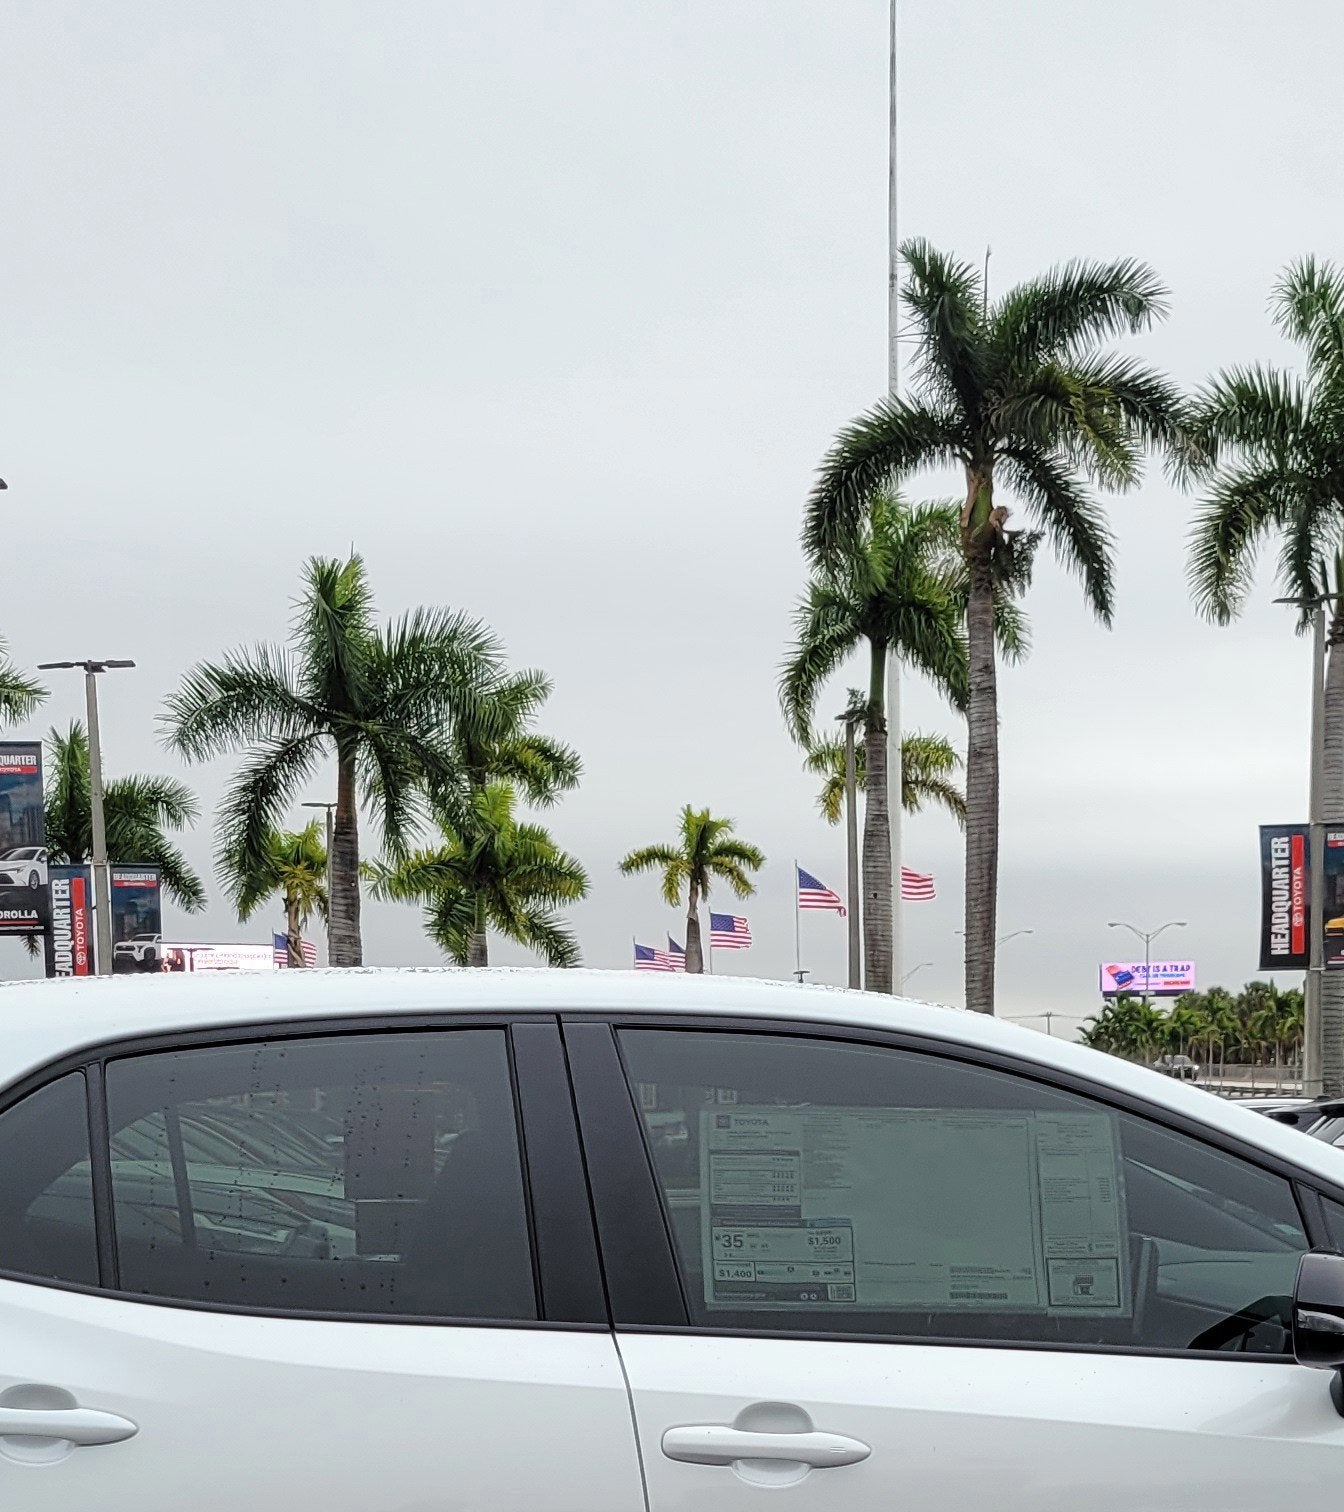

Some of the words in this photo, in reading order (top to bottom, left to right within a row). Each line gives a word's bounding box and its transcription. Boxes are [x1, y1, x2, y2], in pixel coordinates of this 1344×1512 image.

[1270, 836, 1291, 956] HEADQUARTER
[1293, 866, 1303, 912] TOYOTA
[51, 878, 75, 977] EADQUARTER
[75, 908, 85, 951] TOYOTA
[734, 1118, 769, 1126] TOYOTA
[721, 1234, 744, 1248] 35
[807, 1236, 842, 1246] $1,500
[718, 1269, 752, 1279] $1,400
